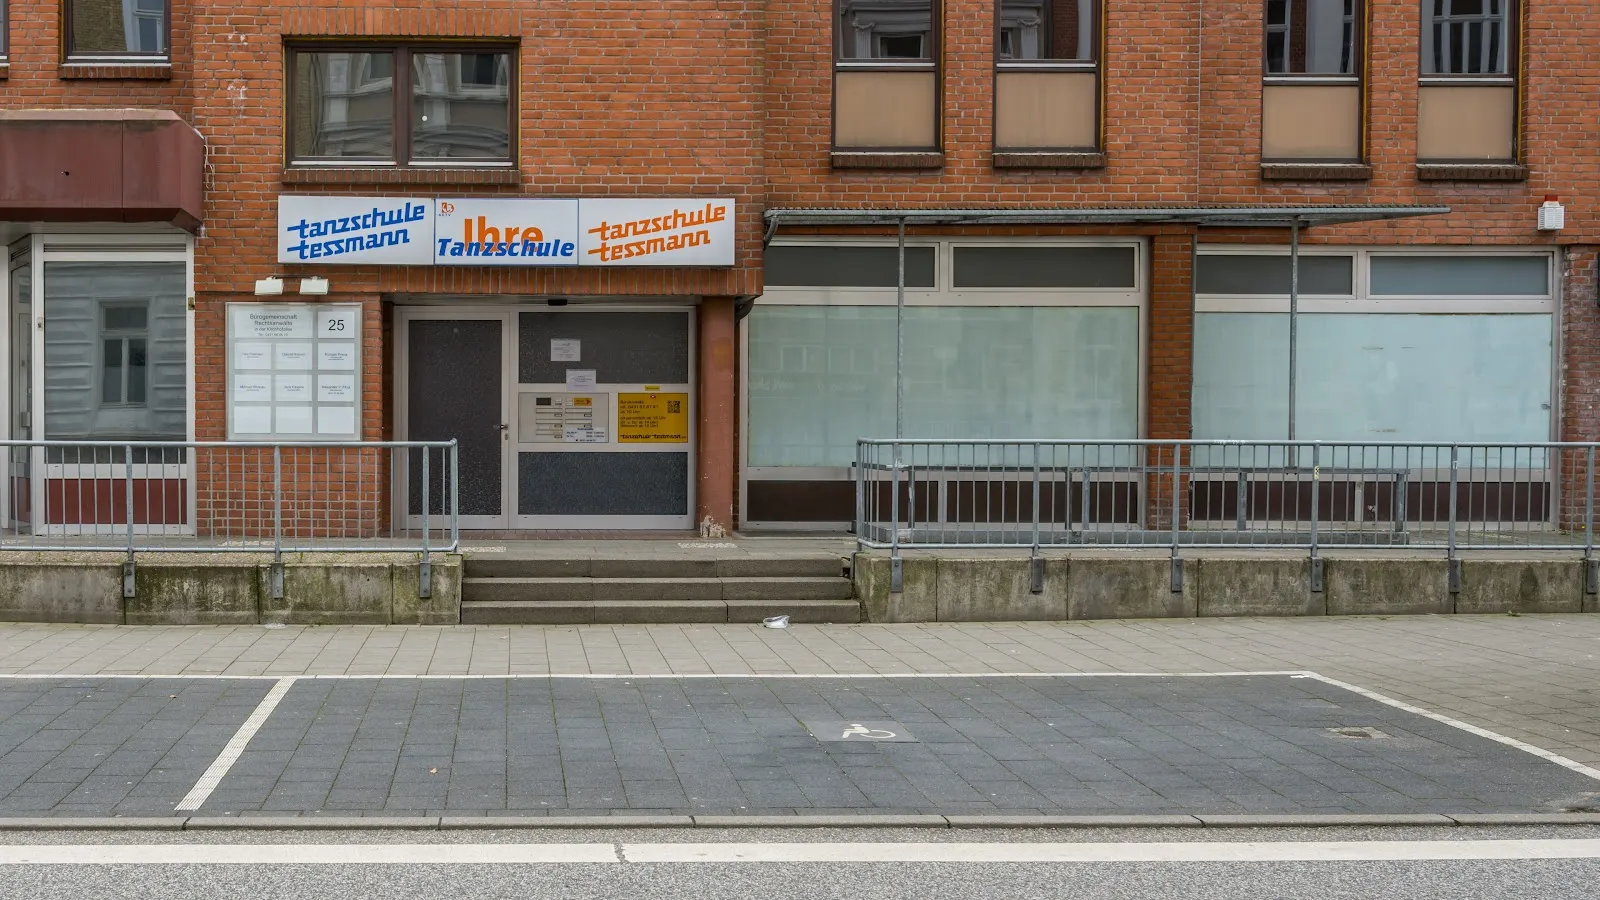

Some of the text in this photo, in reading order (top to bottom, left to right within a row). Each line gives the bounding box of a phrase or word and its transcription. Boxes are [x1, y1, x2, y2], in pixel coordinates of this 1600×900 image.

[287, 202, 425, 239] tanzschule
[464, 215, 544, 252] Ihre
[588, 203, 726, 241] tanzschule
[287, 229, 410, 260] tessmann
[437, 238, 575, 257] Tanzschule
[588, 230, 710, 262] tessmann
[328, 319, 345, 331] 25
